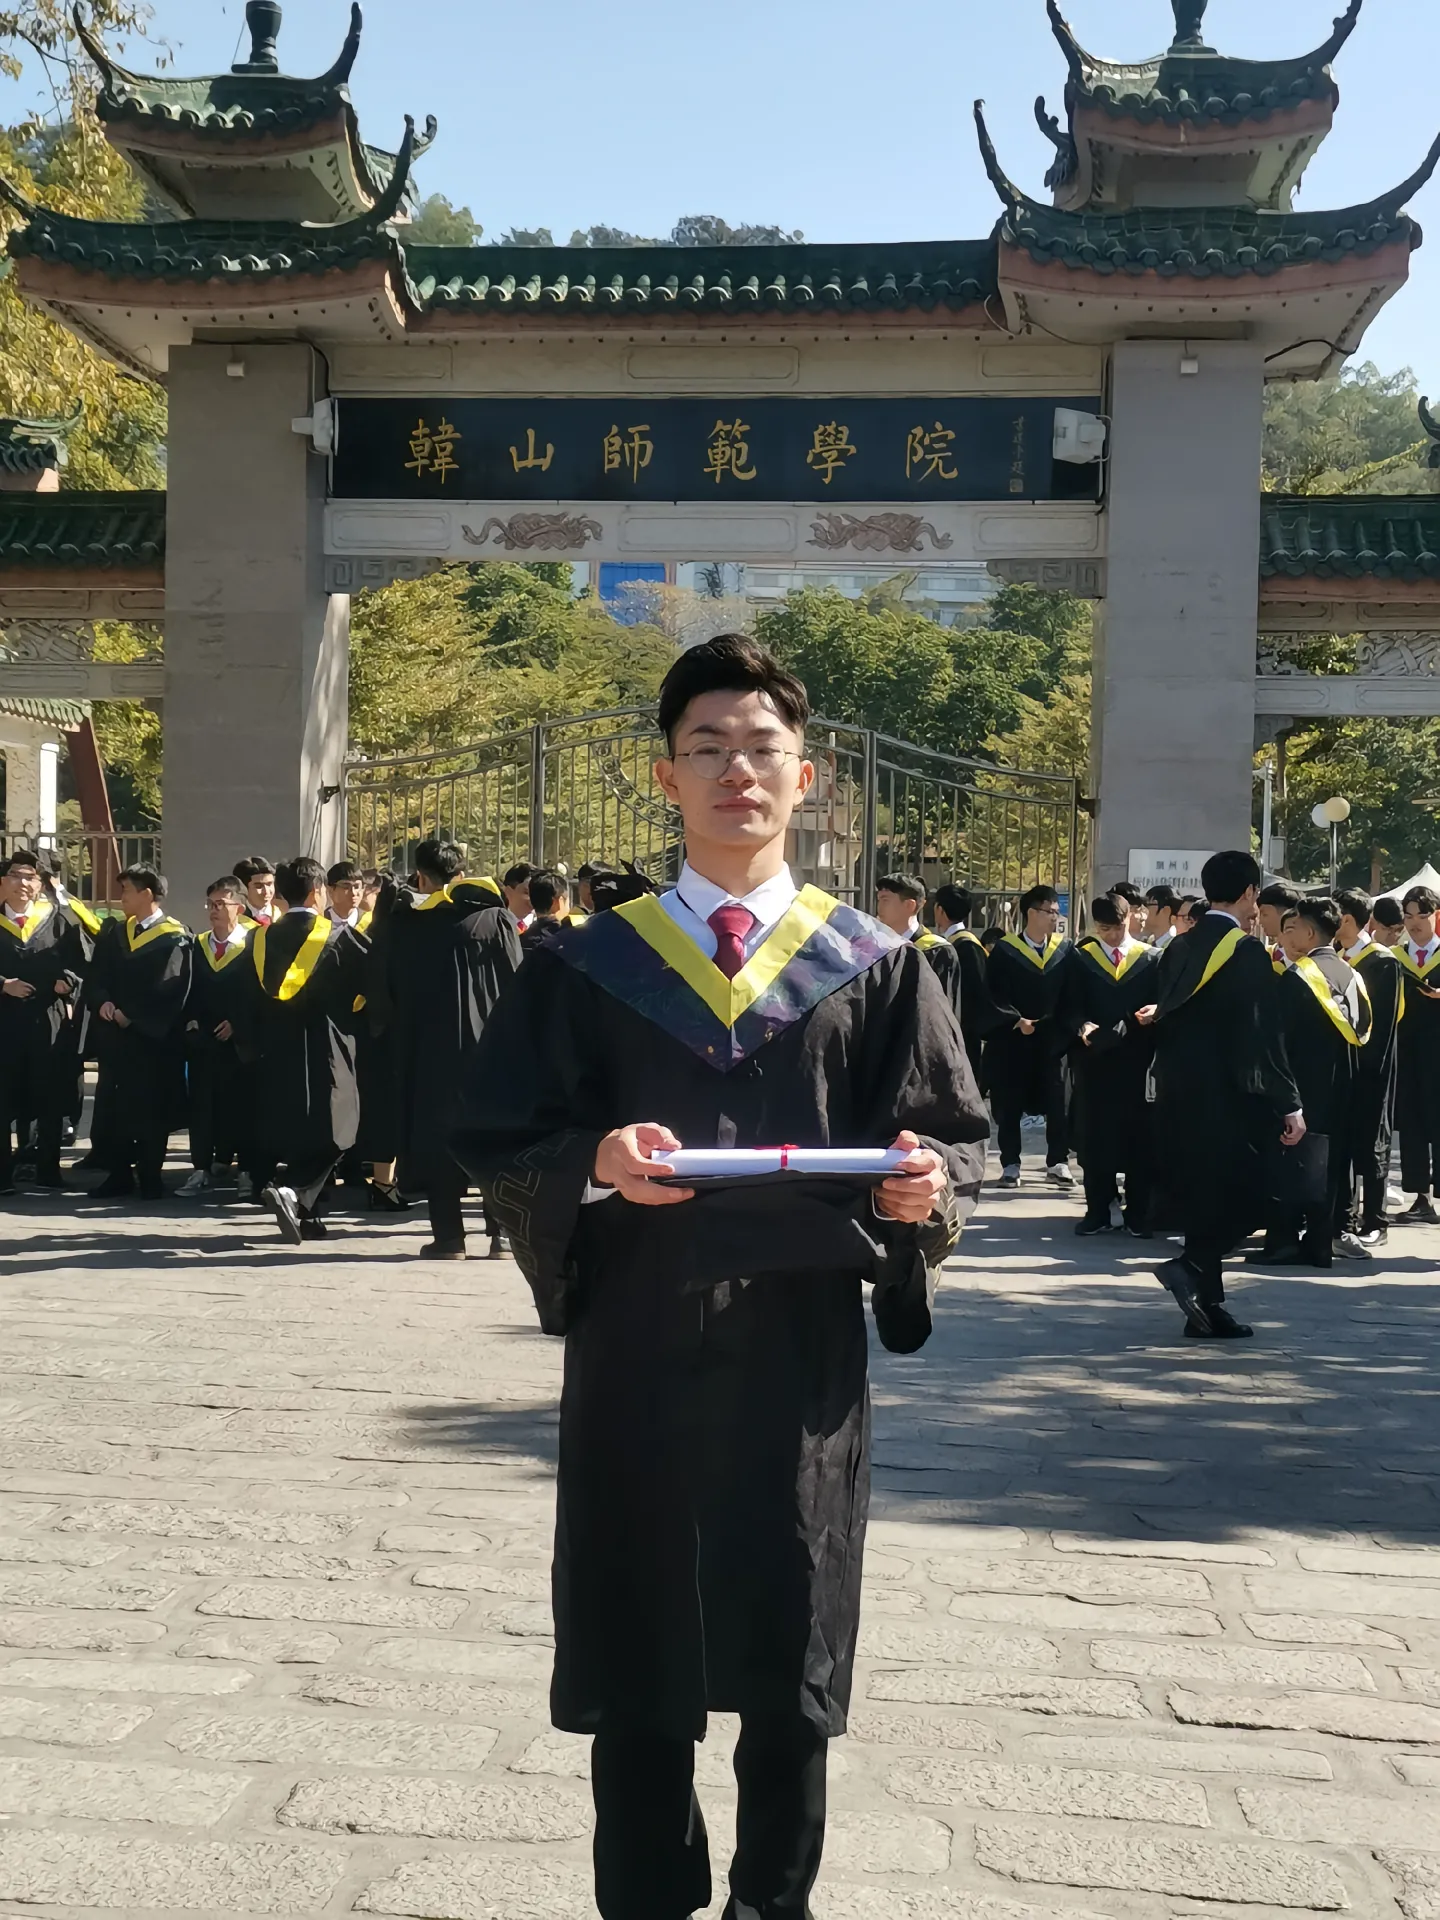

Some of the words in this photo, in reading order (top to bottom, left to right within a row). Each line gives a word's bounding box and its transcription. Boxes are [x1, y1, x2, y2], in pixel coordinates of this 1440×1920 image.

[404, 416, 959, 484] 韓山師範學院
